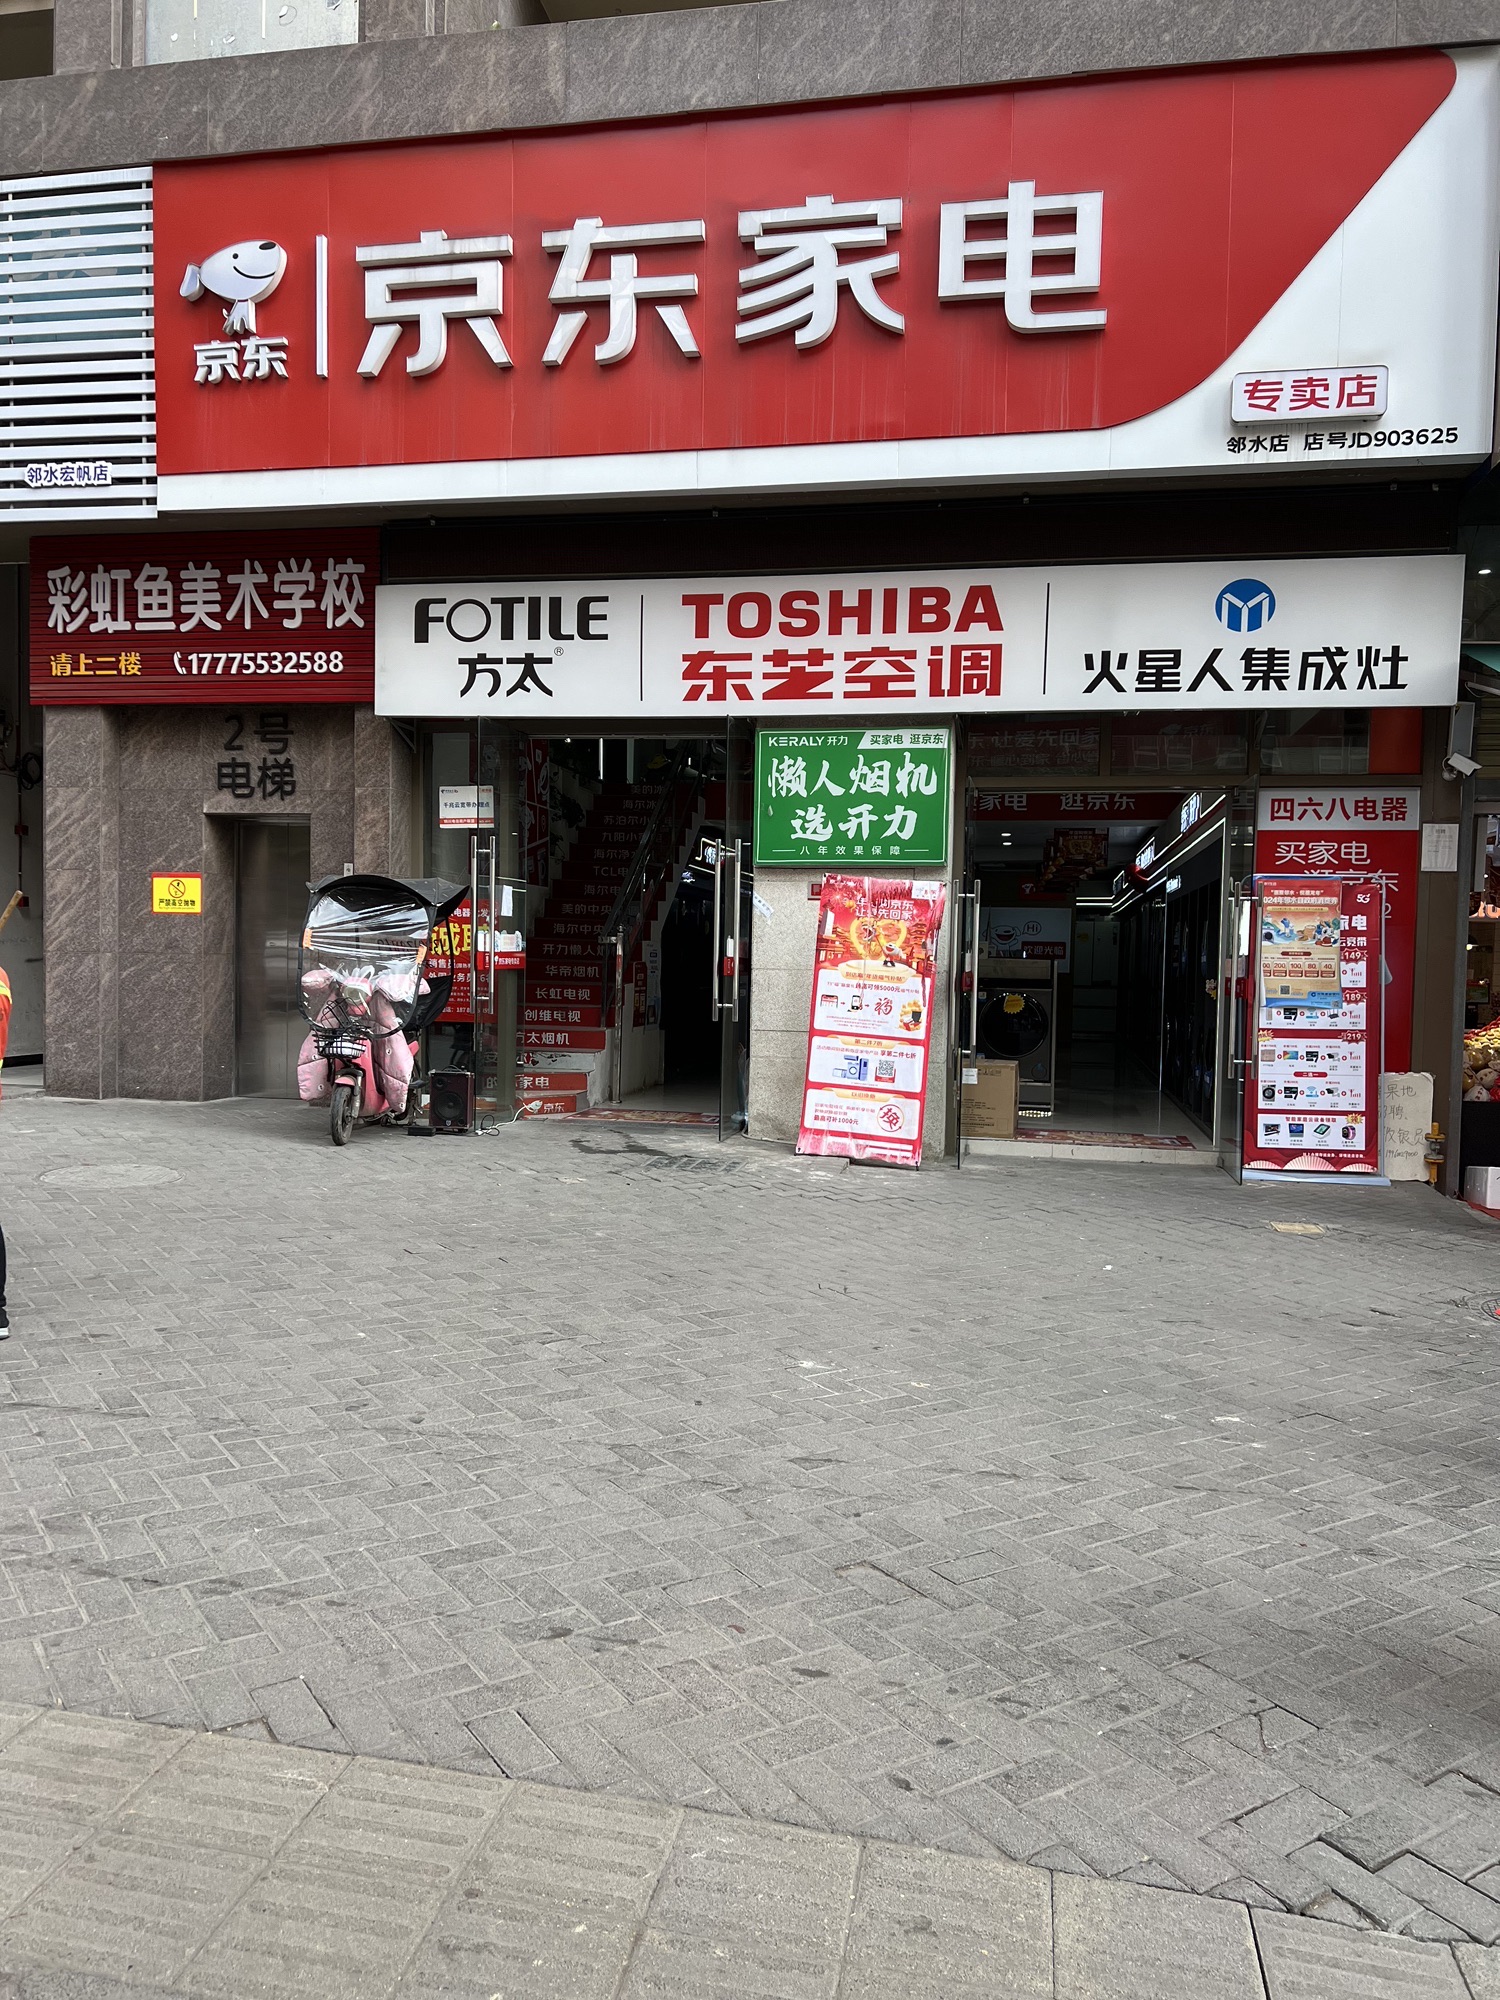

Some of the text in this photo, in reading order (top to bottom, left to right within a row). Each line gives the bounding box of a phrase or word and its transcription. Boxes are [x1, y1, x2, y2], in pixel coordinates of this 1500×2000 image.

[356, 179, 1107, 377] 京东家电
[193, 335, 289, 383] 京东
[1243, 374, 1378, 413] 专卖店
[1226, 427, 1459, 454] 邻水店 店号JD903625
[26, 465, 109, 483] 邻水宏帆店
[46, 557, 366, 633] 彩虹鱼美术学校
[414, 595, 609, 643] FOTILE
[681, 583, 1004, 639] TOSHIBA
[50, 650, 344, 676] 请上二楼 17775532588
[458, 652, 553, 698] 方太
[681, 643, 1003, 699] 东芝空调
[1082, 645, 1409, 694] 火星人集成灶
[224, 713, 294, 754] 2号
[769, 735, 848, 747] KERALY 开力
[870, 733, 944, 745] 买家电 逛京东
[217, 757, 296, 800] 电梯
[767, 751, 938, 799] 懒人烟机
[623, 799, 657, 810] 海尔冰
[974, 793, 1135, 811] 家电 逛京东
[1270, 797, 1408, 821] 四六八电器
[790, 803, 918, 842] 选开力
[1275, 841, 1371, 865] 买家电
[593, 866, 629, 877] TCL电
[584, 884, 621, 896] 海尔电
[1356, 893, 1370, 904] 5G
[1026, 924, 1038, 932] Hi
[1023, 945, 1064, 956] 欢迎光临
[1344, 951, 1361, 959] 149
[545, 965, 600, 979] 华帝烟机
[535, 987, 590, 1001] 长虹电视
[1345, 993, 1361, 1001] 189
[524, 1008, 580, 1023] 创维电视
[879, 1107, 900, 1129] 换
